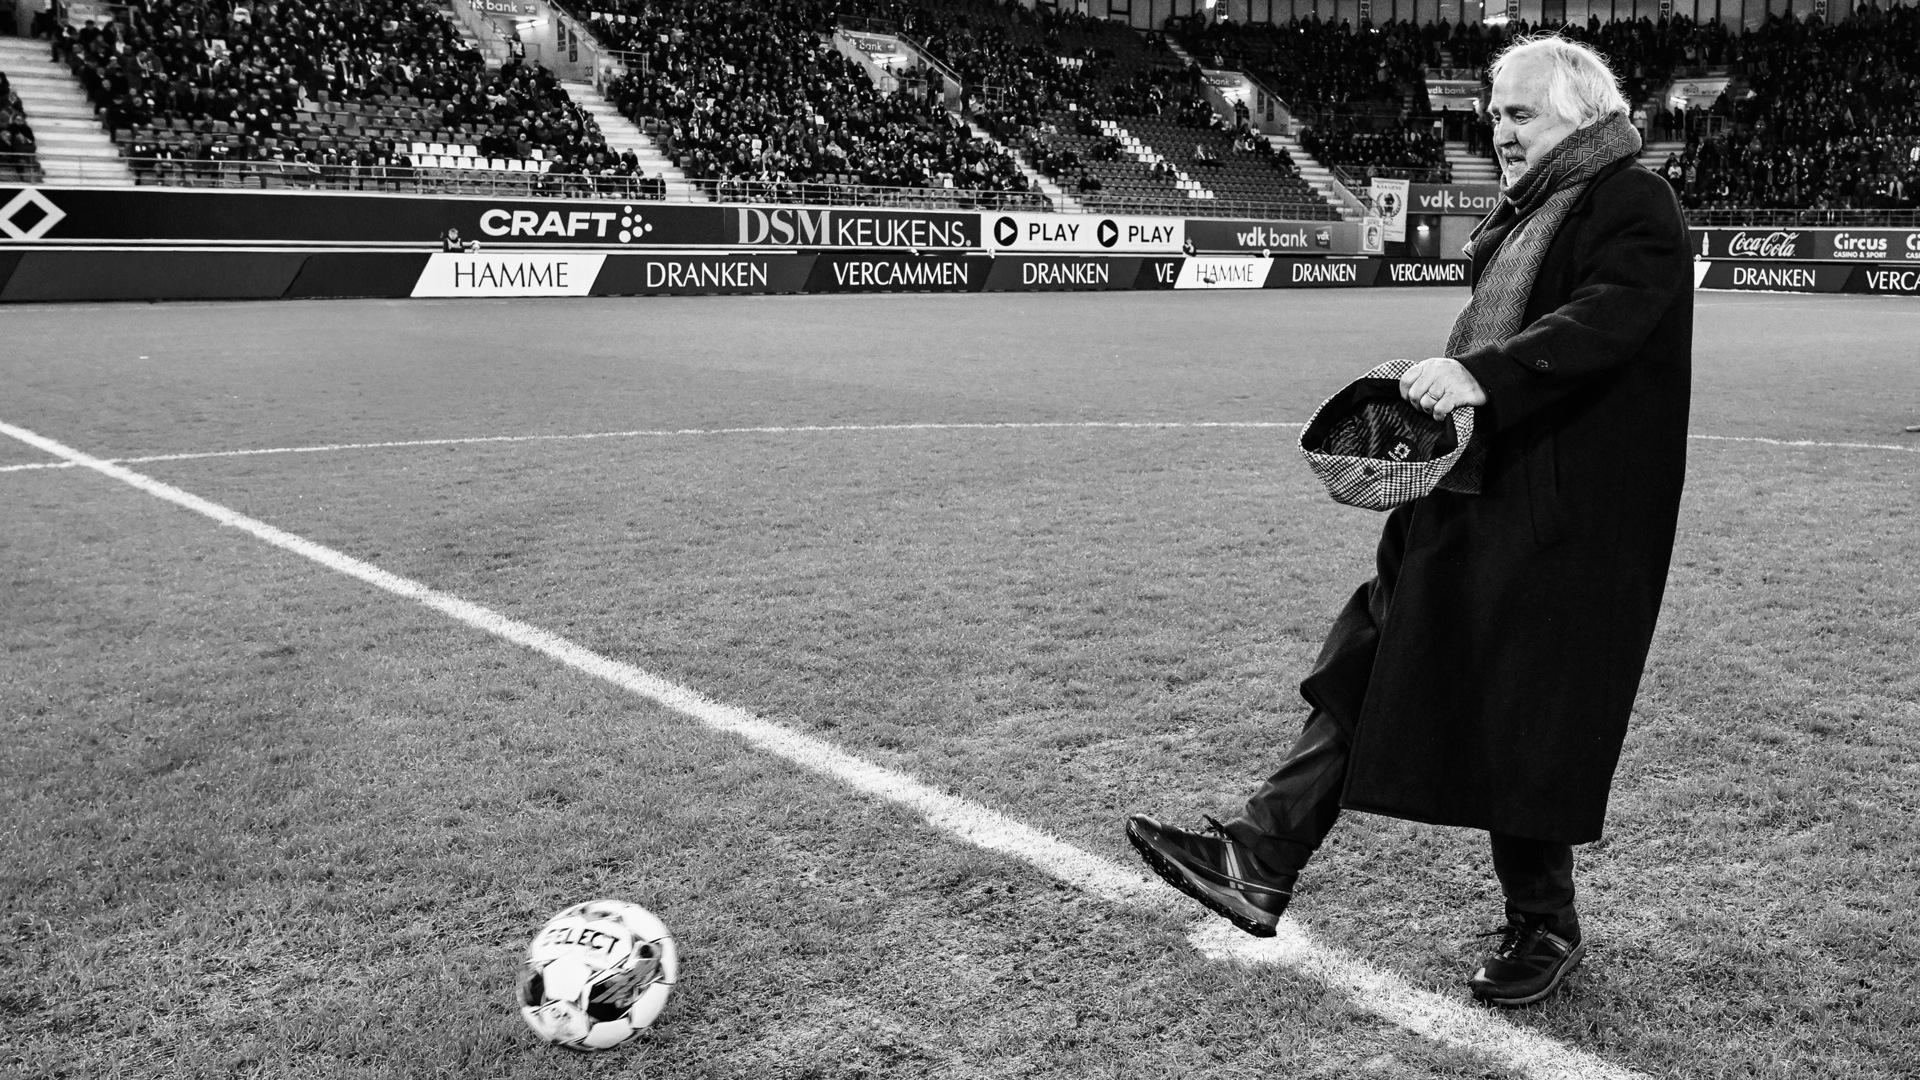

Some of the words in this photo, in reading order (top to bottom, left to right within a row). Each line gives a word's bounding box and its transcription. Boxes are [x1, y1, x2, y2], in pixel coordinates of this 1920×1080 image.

[1427, 85, 1443, 94] vdk
[1445, 86, 1466, 95] bank
[1419, 190, 1455, 208] vdk
[479, 208, 617, 237] CRAFT
[738, 208, 831, 245] DSM
[1029, 223, 1080, 241] PLAY
[1128, 225, 1175, 243] PLAY
[1237, 227, 1266, 247] vdk
[1269, 228, 1308, 248] bank
[1833, 233, 1887, 251] Circus
[1728, 232, 1799, 257] Coca-Cola
[1866, 251, 1887, 259] SPORT
[455, 262, 568, 288] HAMME
[646, 262, 767, 287] DRANKEN
[833, 262, 968, 285] VERCAMMEN
[1023, 262, 1109, 284] DRANKEN
[1155, 263, 1174, 283] VE
[1196, 263, 1254, 282] HAMME
[1292, 263, 1356, 282] DRANKEN
[1390, 263, 1464, 281] VERCAMMEN
[1733, 267, 1815, 287] DRANKEN
[542, 927, 620, 954] SELECT
